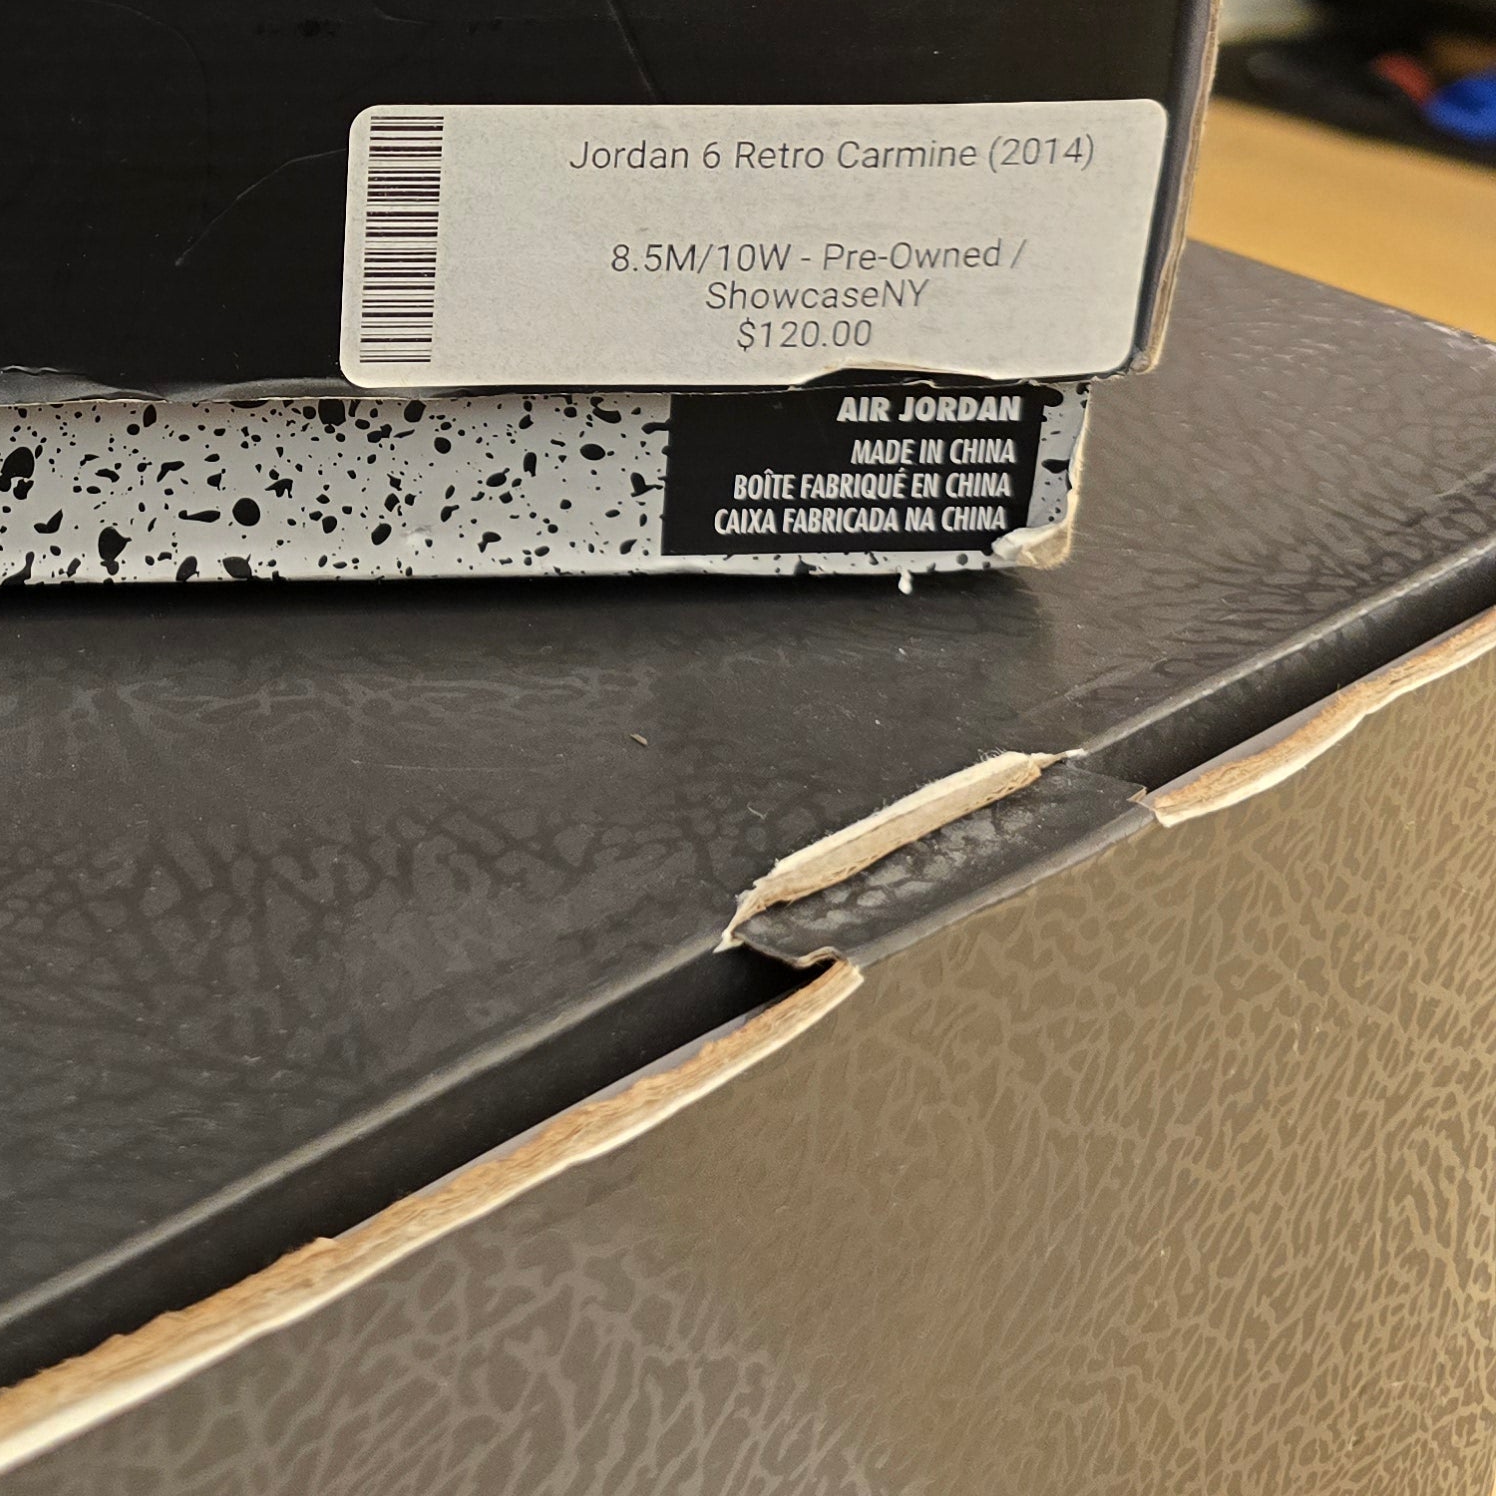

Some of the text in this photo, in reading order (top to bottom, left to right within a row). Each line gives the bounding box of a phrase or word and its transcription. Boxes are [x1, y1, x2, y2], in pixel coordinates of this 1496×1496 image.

[569, 133, 1094, 173] Jordan 6 Retro Carmine (2014)
[611, 243, 791, 273] 8.5M/10W
[823, 238, 1002, 271] Pre-Owned
[705, 278, 930, 310] ShowcaseNY
[736, 317, 872, 352] $120.00
[836, 395, 1022, 422] AIR JORDAN
[851, 438, 1016, 465] MADE IN CHINA
[734, 467, 1011, 501] BOÎTE FABRIQUÉ EN CHINA
[714, 505, 1006, 535] CAIXA FABRICADA NA CHINA
